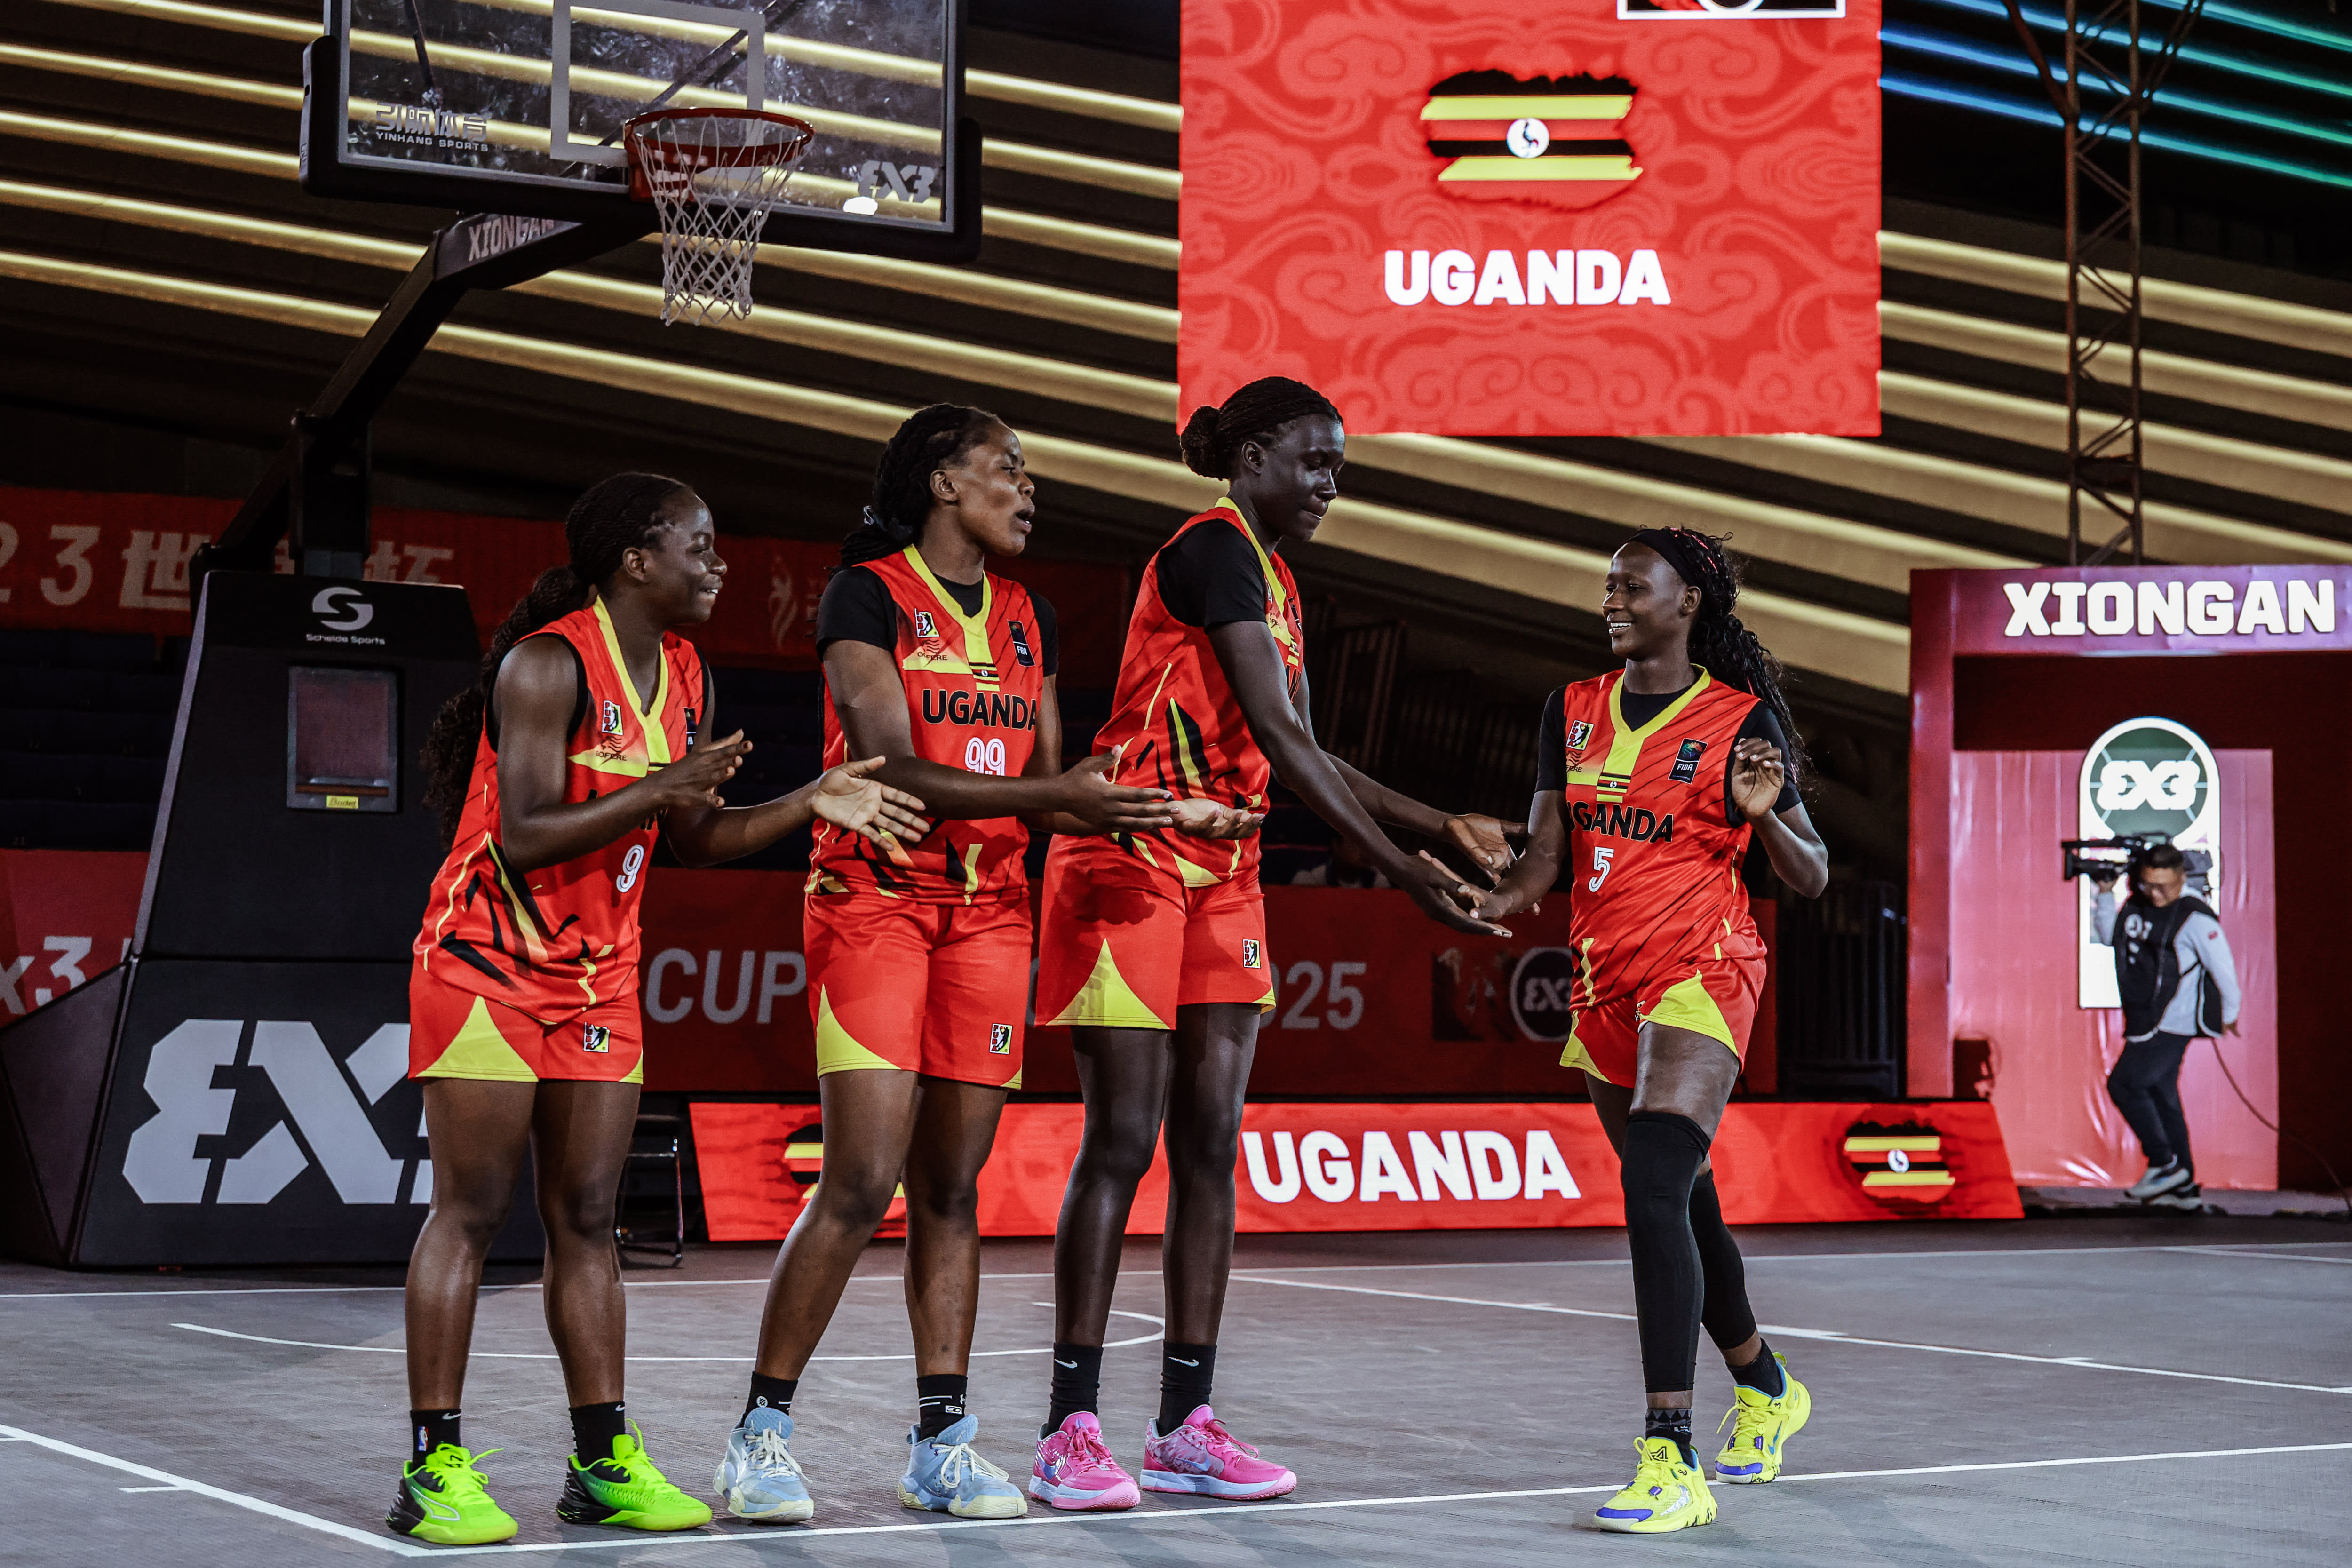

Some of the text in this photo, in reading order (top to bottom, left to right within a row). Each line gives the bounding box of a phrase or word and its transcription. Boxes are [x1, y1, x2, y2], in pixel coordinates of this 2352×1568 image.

[376, 132, 489, 152] YINHANG SPORTS
[1385, 249, 1671, 306] UGANDA
[2002, 579, 2336, 637] XIONGAN
[350, 636, 386, 645] Sports
[965, 737, 1005, 776] 99
[616, 844, 644, 892] 9
[1589, 846, 1614, 892] 5
[645, 947, 806, 1025] CUP
[122, 1019, 434, 1204] 3X
[1241, 1130, 1581, 1203] UGANDA
